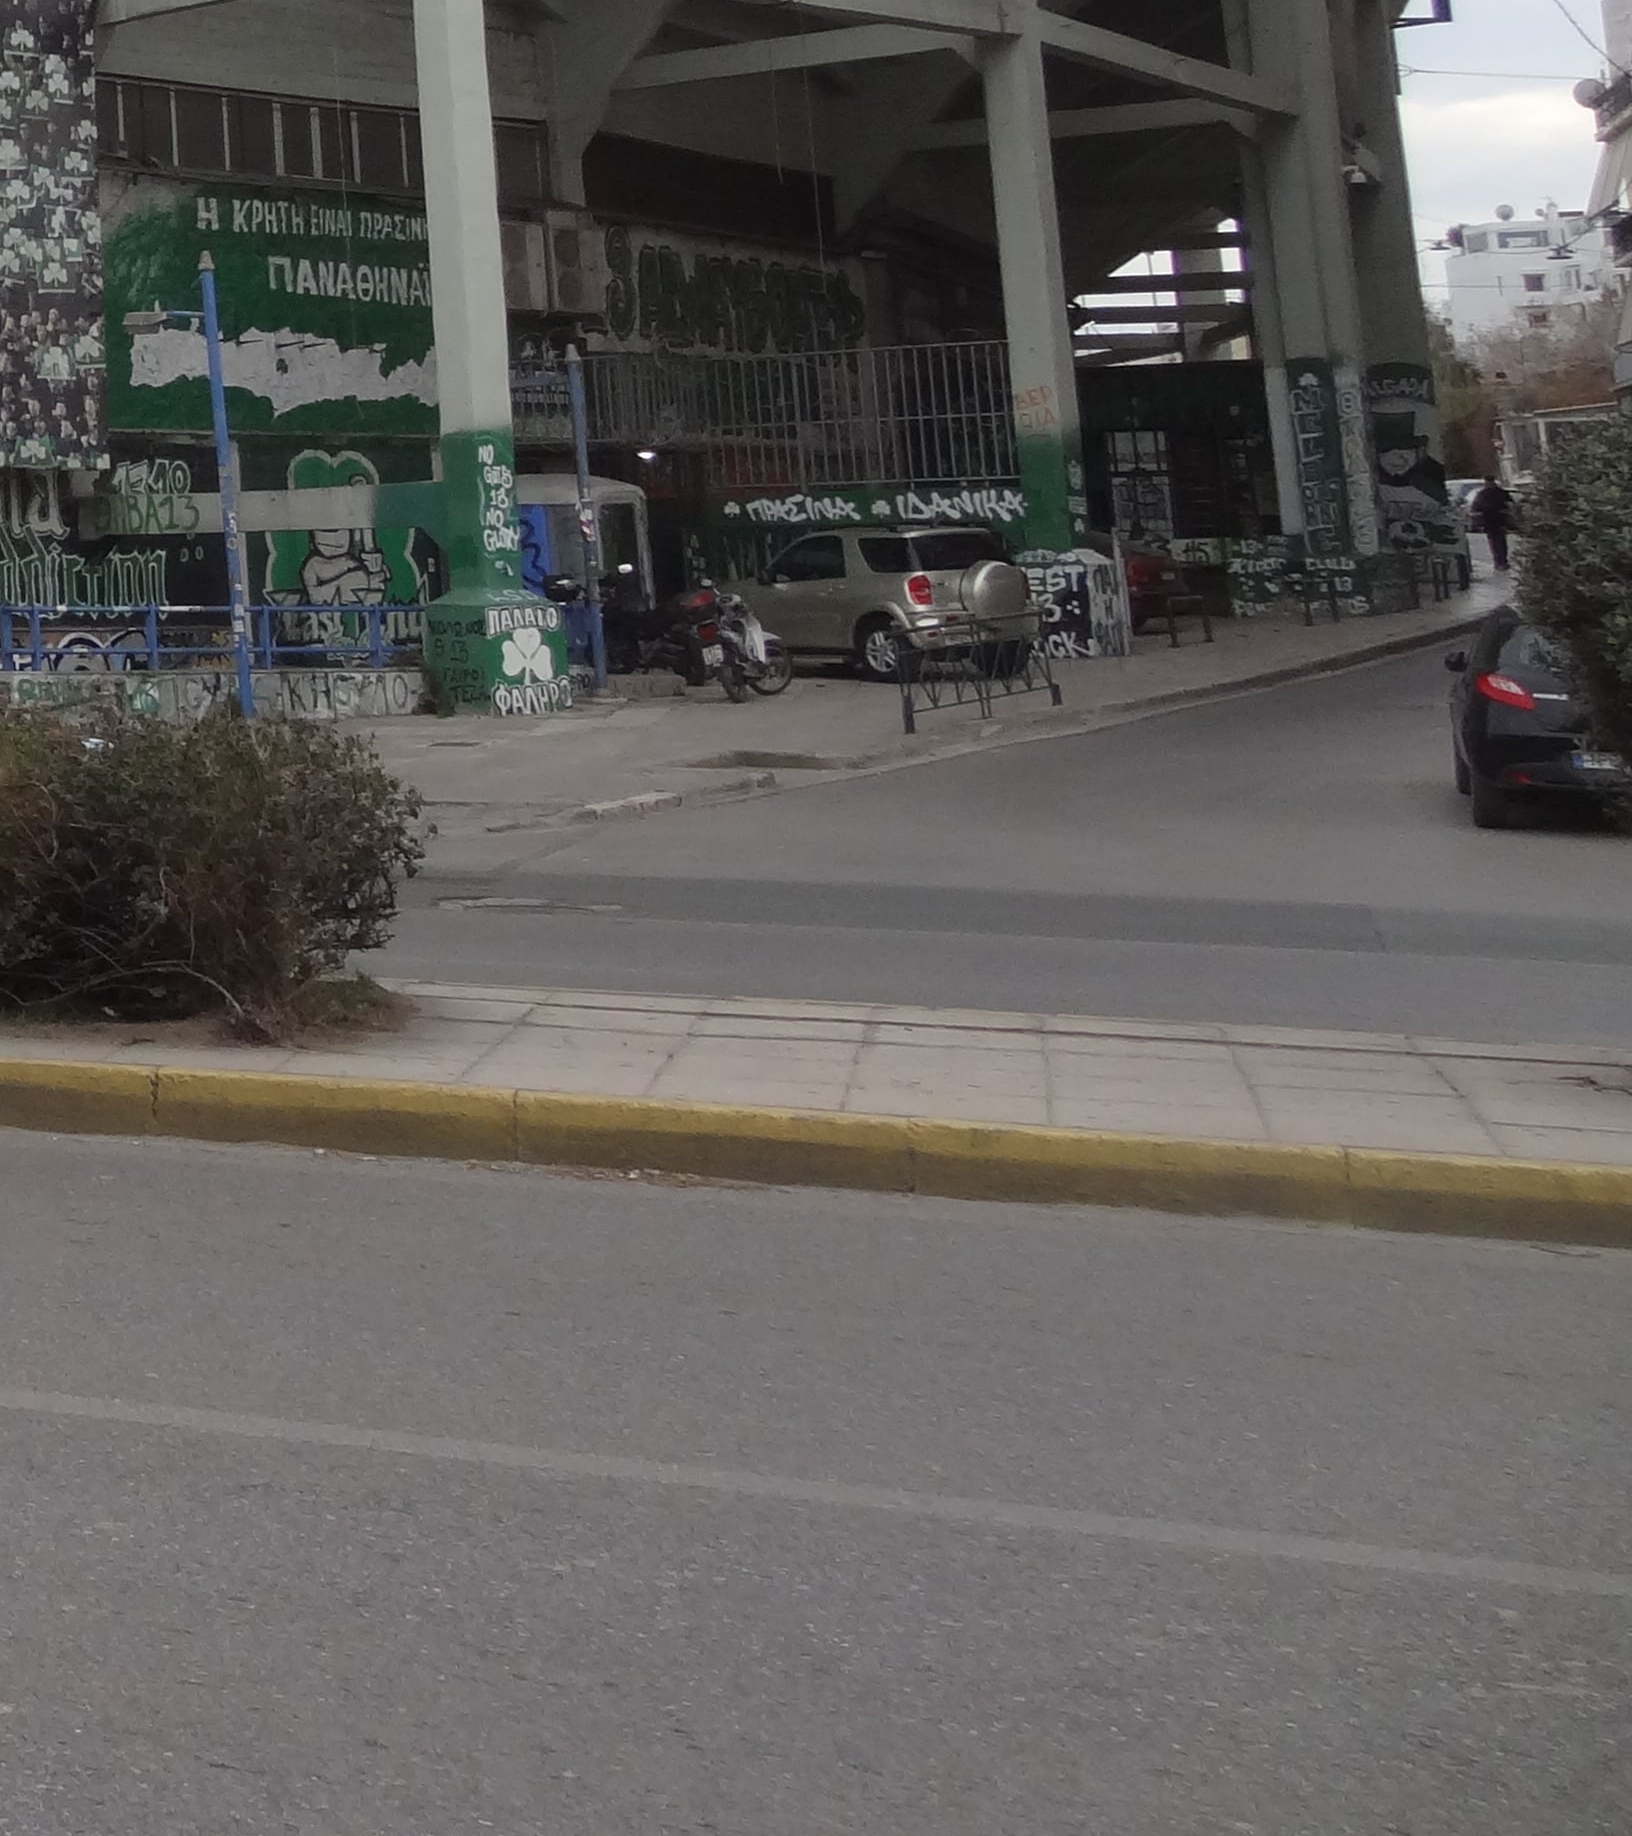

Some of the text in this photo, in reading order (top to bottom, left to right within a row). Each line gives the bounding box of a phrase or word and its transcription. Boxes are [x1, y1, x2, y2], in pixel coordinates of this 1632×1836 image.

[196, 196, 220, 231] Η
[232, 199, 305, 235] ΚΡΗΤΗ
[310, 204, 352, 237] ΕΙΝΑΙ
[268, 255, 432, 307] ΠΑΝΑΘΗΝΑΪ
[478, 444, 494, 465] NO
[746, 488, 1028, 524] ΠΡΑΣΙΝΑ ΙΔΑΝΙΚΑ
[1020, 565, 1084, 592] EST
[486, 605, 562, 639] ΠΑΛΑΙΟ
[491, 675, 574, 717] ΦΑΛΗΡΟ
